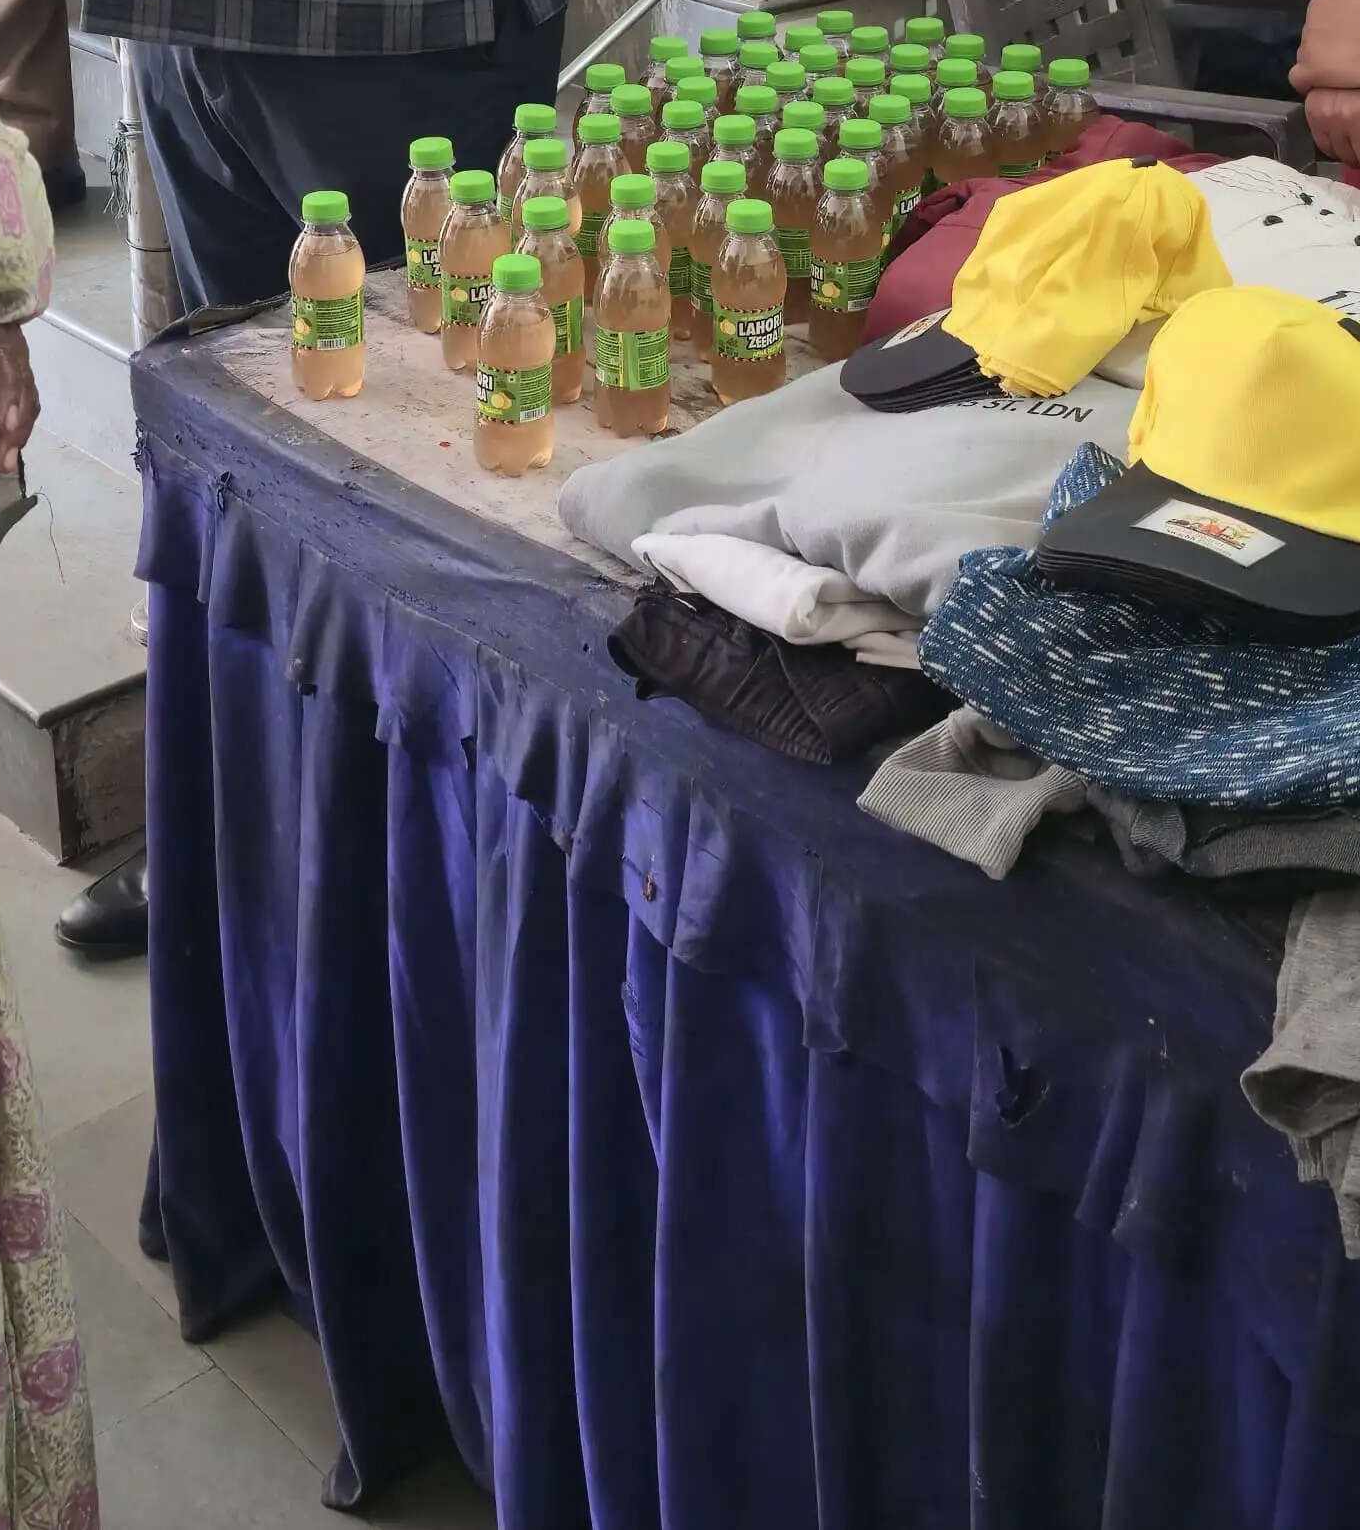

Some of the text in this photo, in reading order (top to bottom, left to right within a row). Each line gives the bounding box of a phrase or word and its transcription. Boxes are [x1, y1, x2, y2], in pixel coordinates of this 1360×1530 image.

[737, 311, 782, 337] LAHORI
[747, 331, 779, 350] ZEERA
[1027, 400, 1093, 423] LDN
